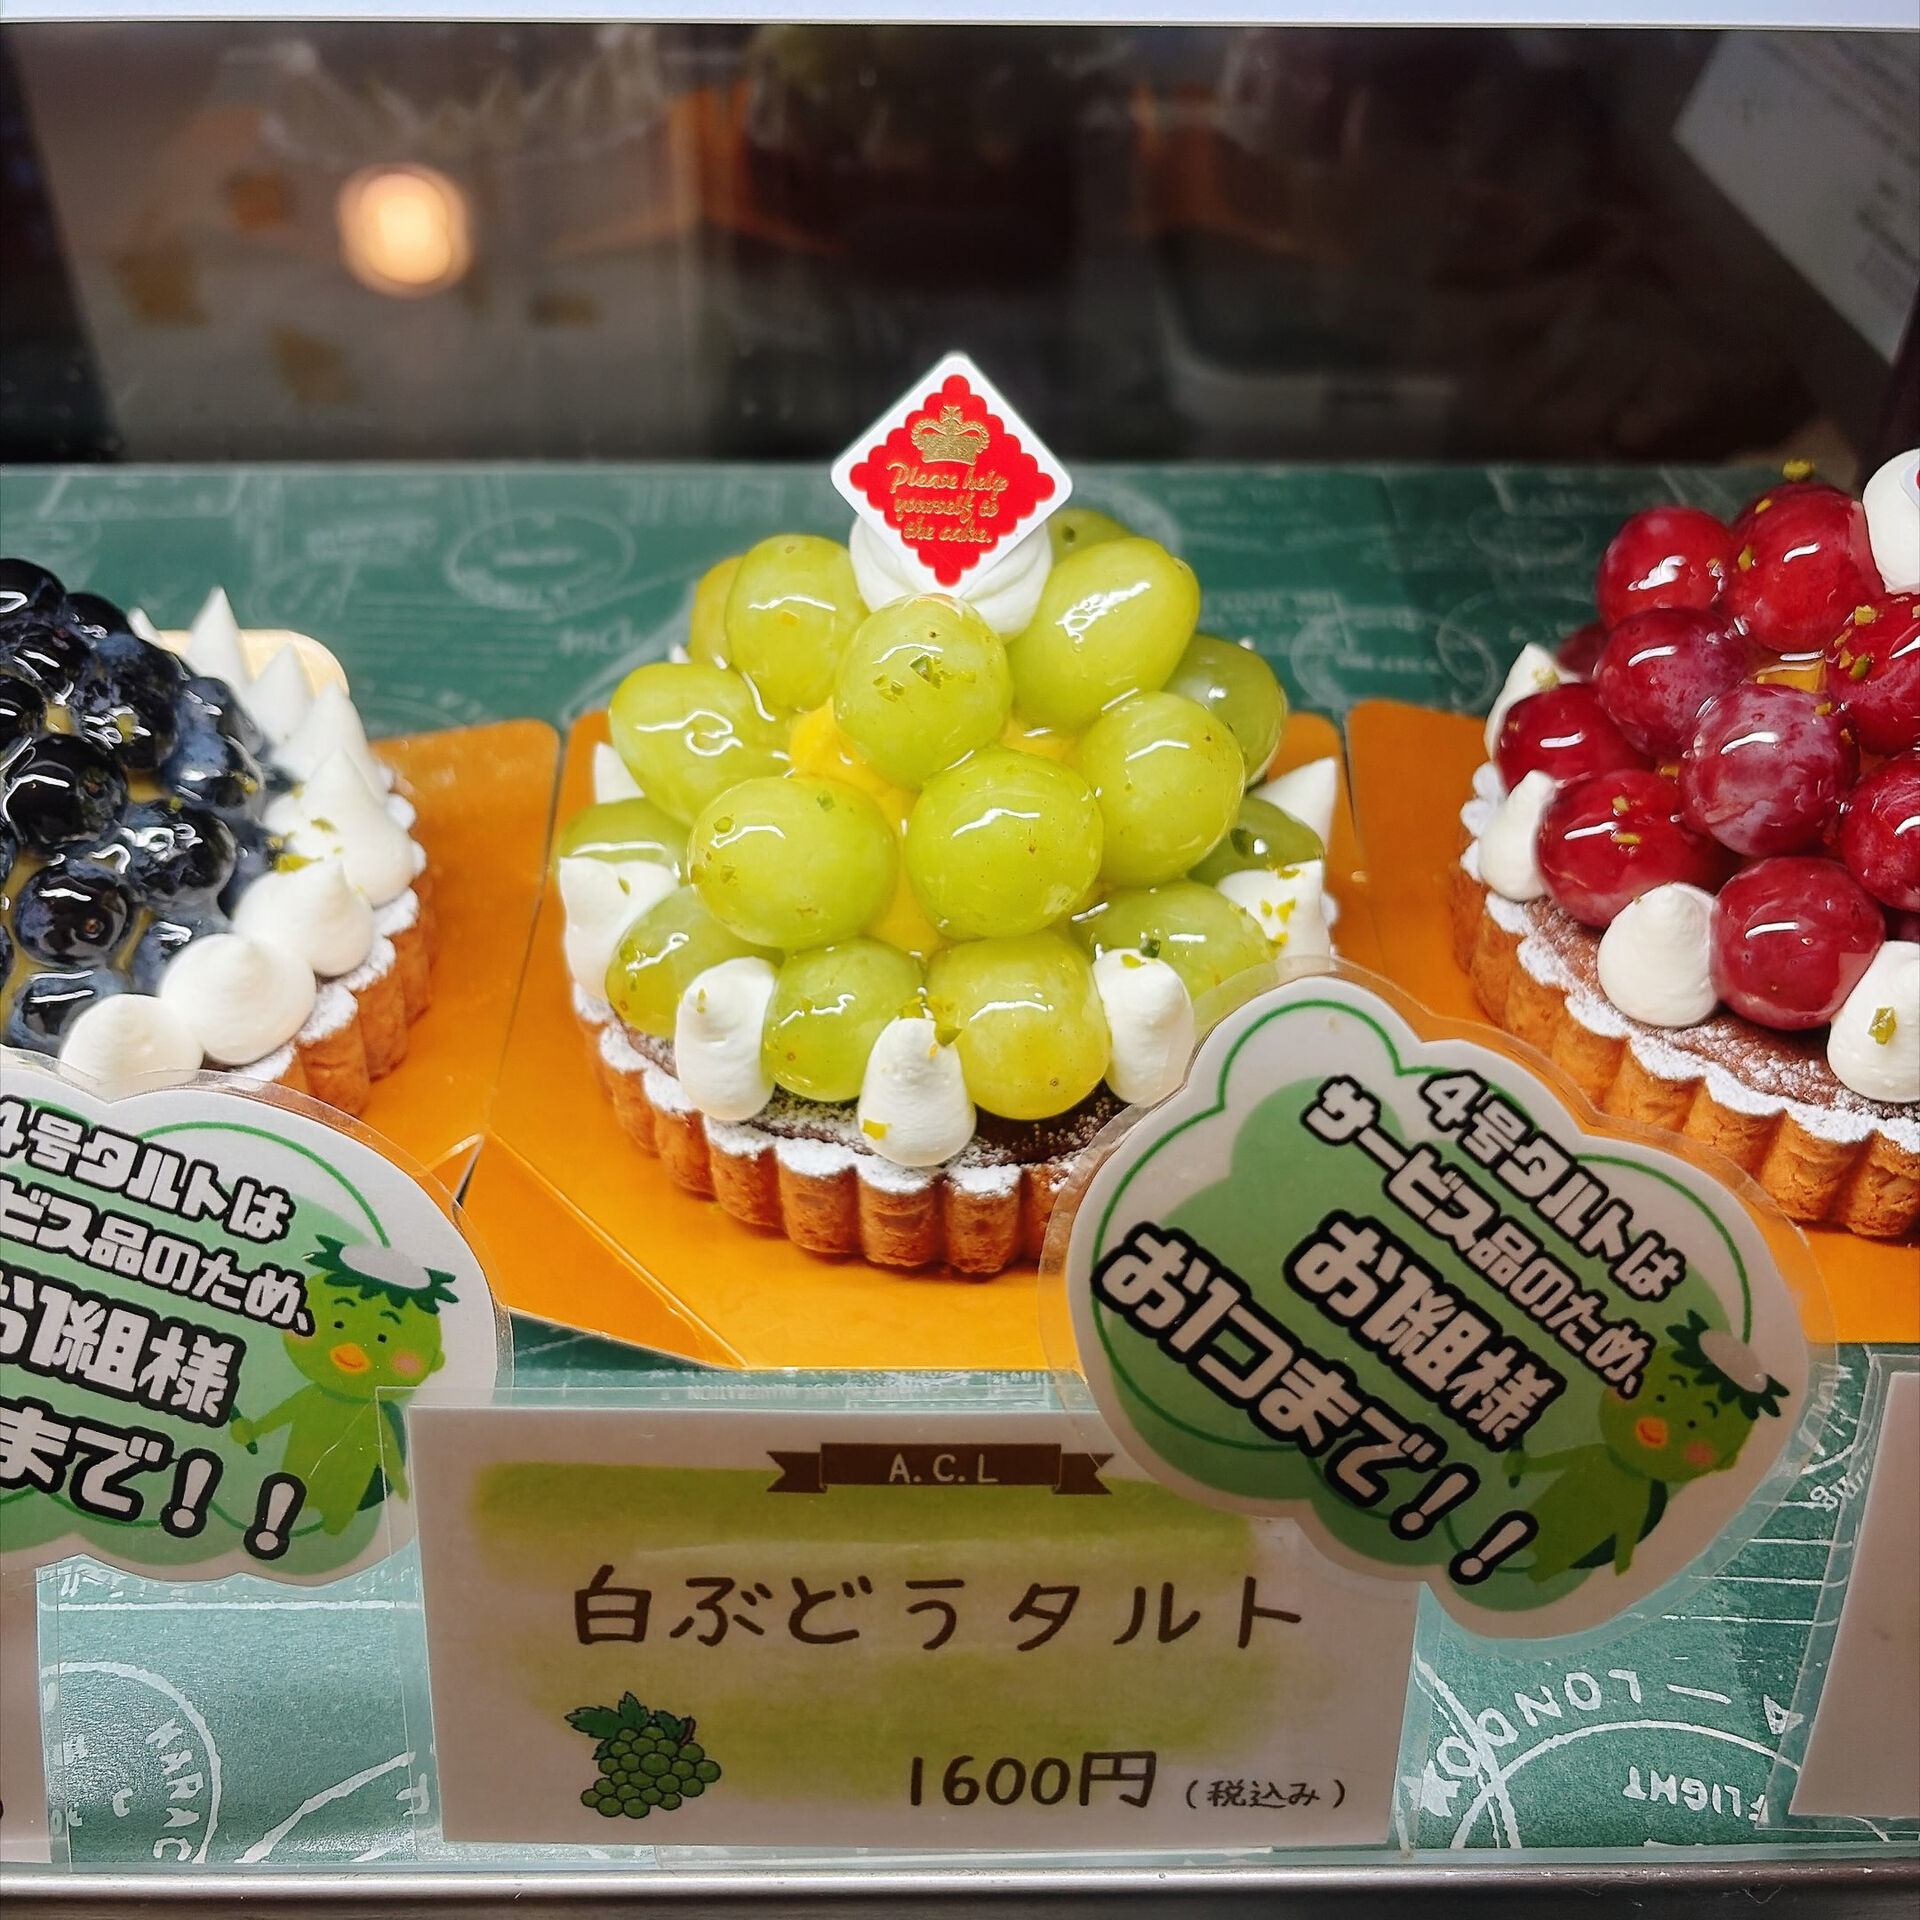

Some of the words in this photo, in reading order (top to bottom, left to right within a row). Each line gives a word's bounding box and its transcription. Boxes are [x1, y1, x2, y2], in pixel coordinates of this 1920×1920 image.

[886, 462, 958, 494] Please
[962, 466, 1009, 501] help
[894, 492, 975, 523] yourself
[979, 499, 999, 517] to
[903, 516, 934, 540] the
[1419, 1070, 1685, 1299] 4号タルトは
[1302, 1075, 1656, 1398] サービス品のため、
[573, 1563, 1303, 1651] 白ぶどうタルト
[909, 1750, 1157, 1808] 1600円
